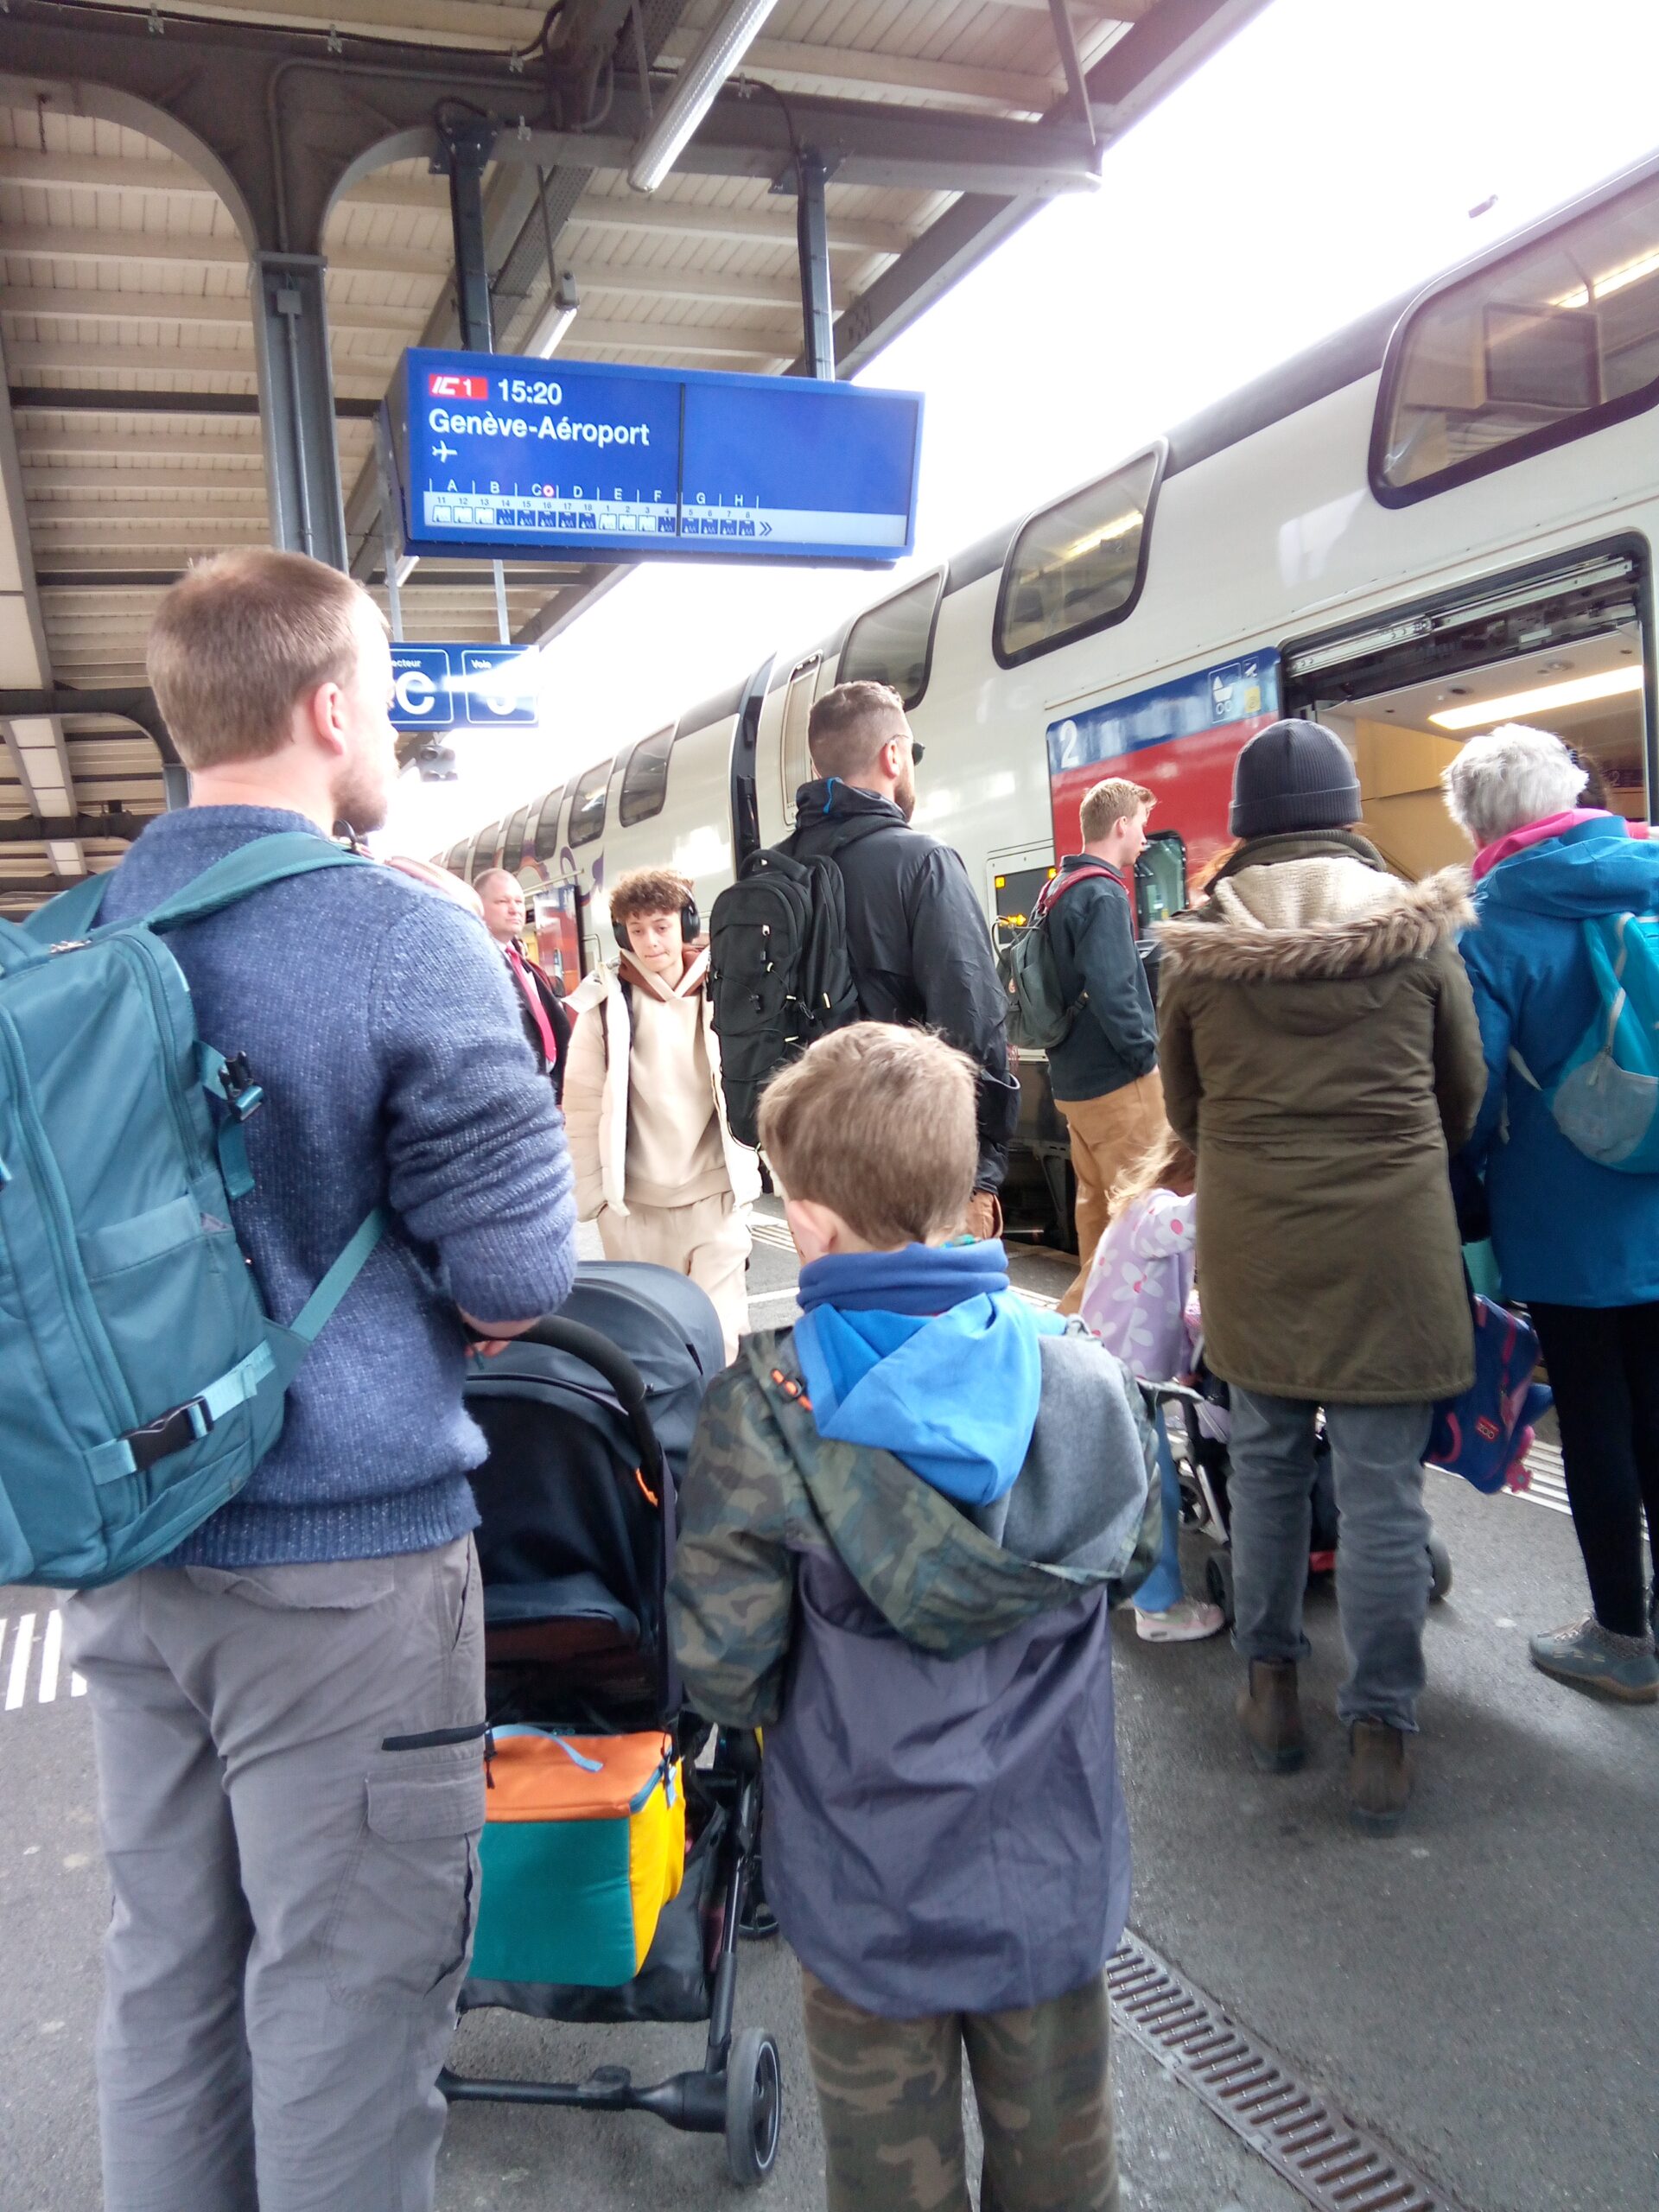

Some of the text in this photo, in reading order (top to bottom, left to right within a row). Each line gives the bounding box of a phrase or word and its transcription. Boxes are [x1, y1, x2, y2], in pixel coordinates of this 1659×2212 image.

[431, 376, 563, 405] IC 1 15:20
[429, 408, 650, 448] Genève-Aéroport
[447, 479, 743, 506] A B C D E F G H
[391, 658, 422, 668] ecteur
[1060, 720, 1079, 769] 2
